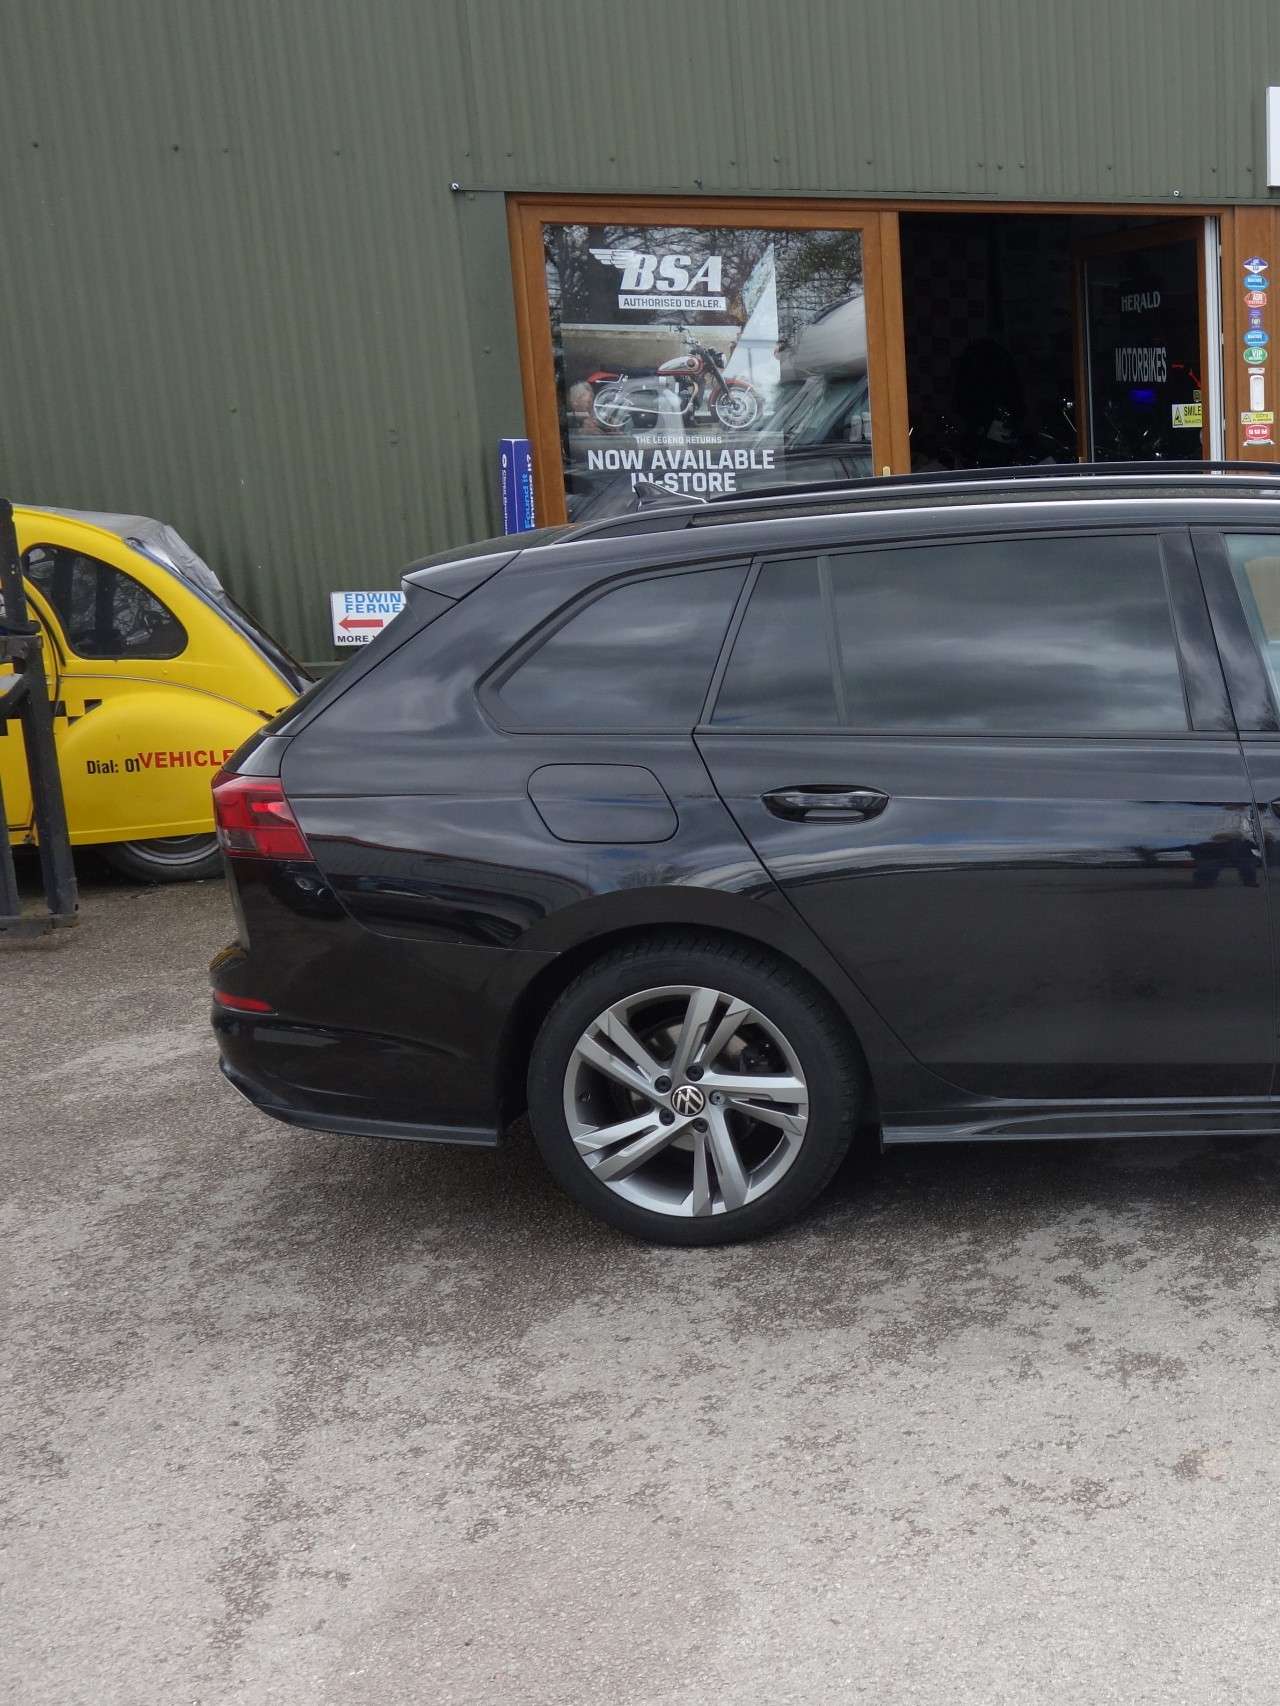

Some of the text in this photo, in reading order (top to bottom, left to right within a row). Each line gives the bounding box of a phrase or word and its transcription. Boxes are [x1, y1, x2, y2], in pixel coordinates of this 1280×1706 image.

[618, 252, 722, 292] BSA
[623, 297, 682, 308] AUTHORISED
[1121, 291, 1161, 313] HERALD
[1115, 347, 1167, 383] MOTORBIKES
[635, 436, 722, 445] THE LEGEND RETURNS
[587, 449, 775, 470] NOW AVAILABLE
[631, 472, 737, 493] IN-STORE
[344, 593, 401, 604] EDWIN
[337, 635, 369, 643] MORE
[86, 758, 140, 775] Dial: 01
